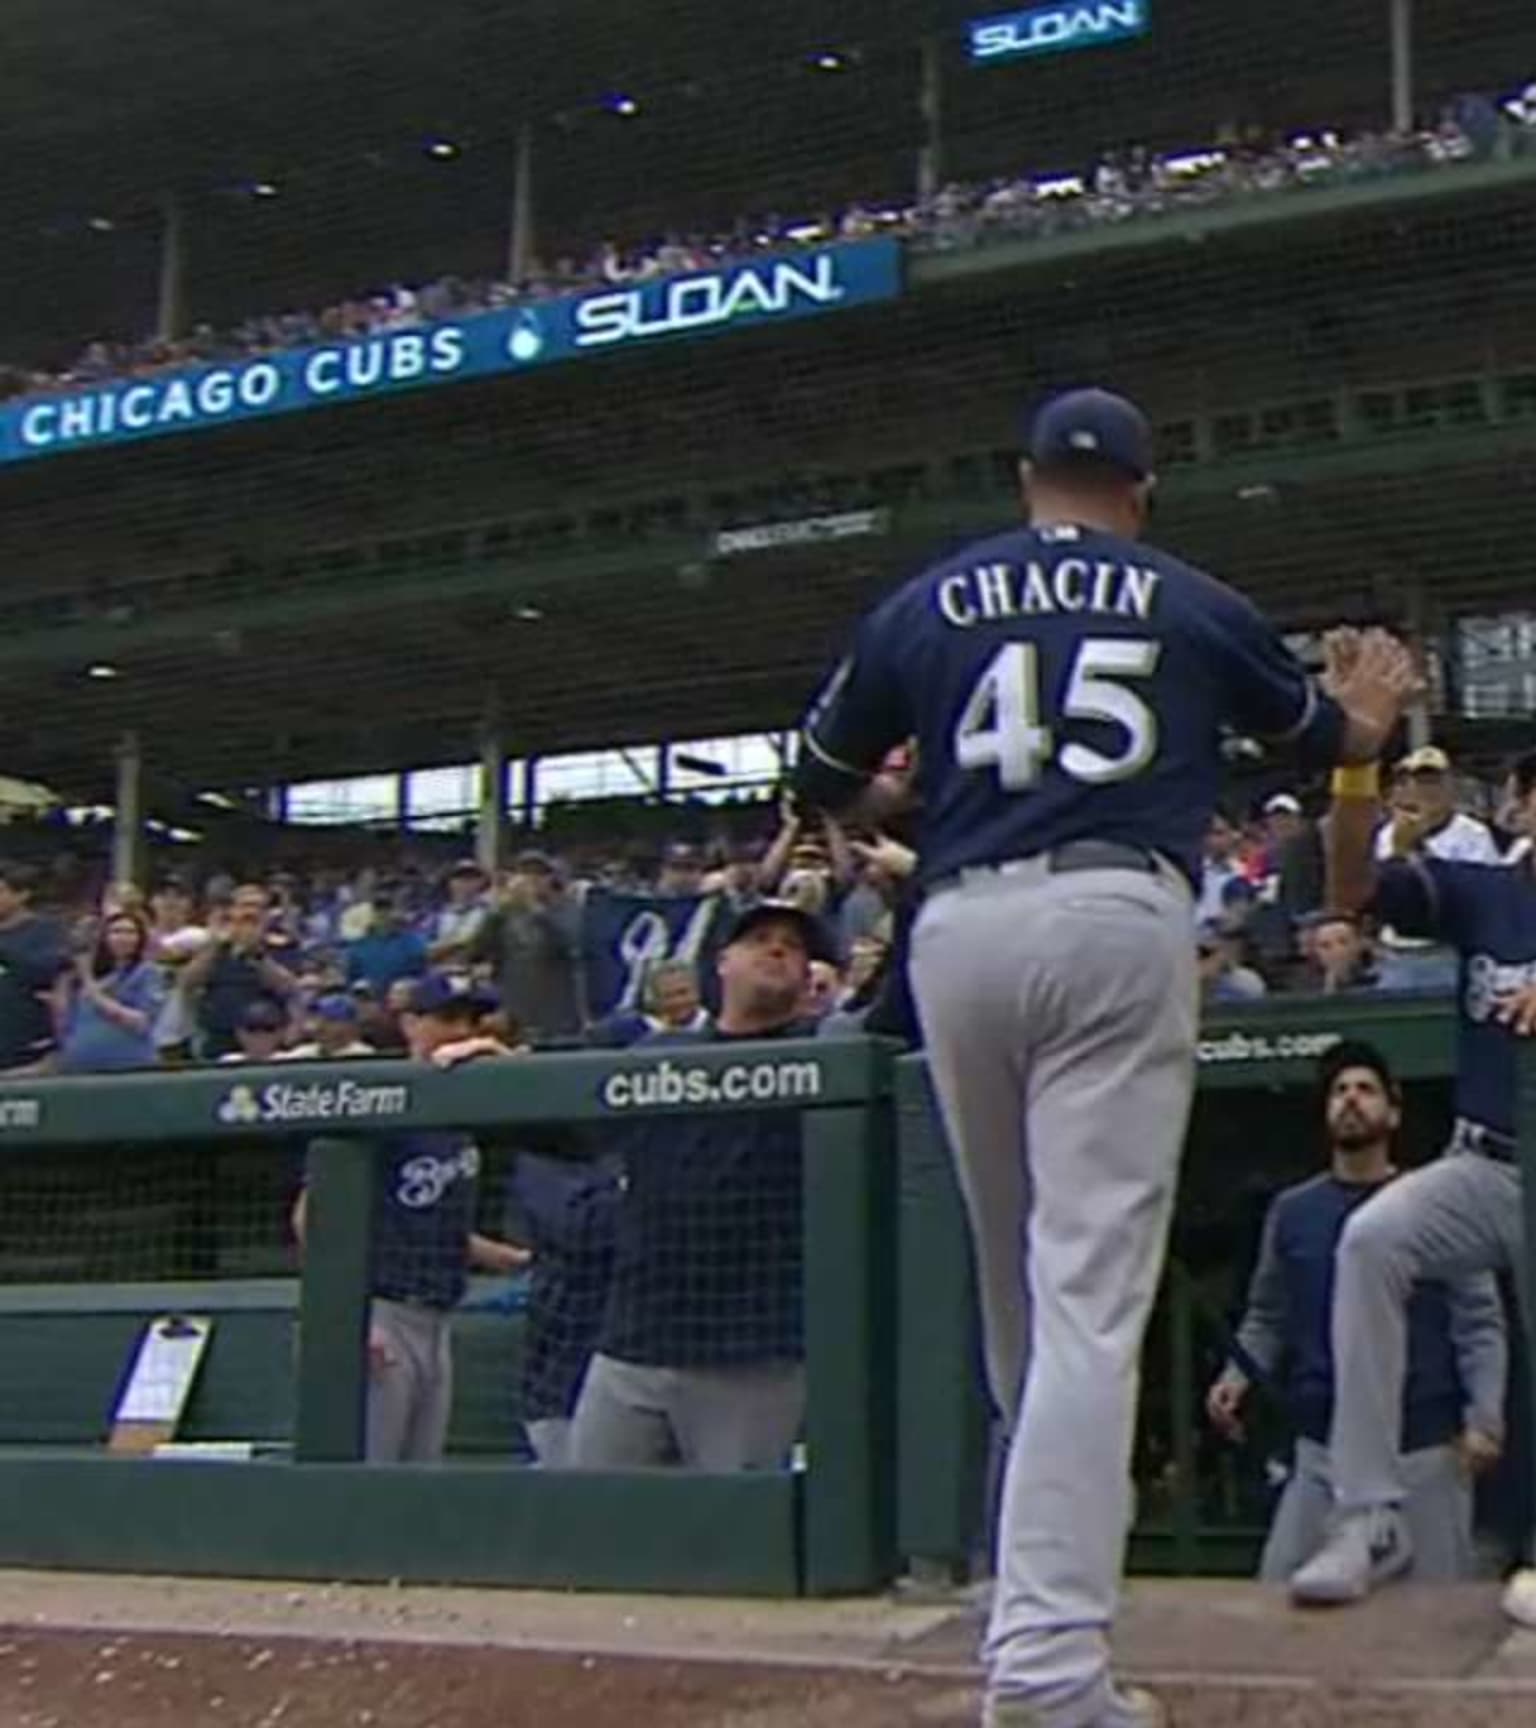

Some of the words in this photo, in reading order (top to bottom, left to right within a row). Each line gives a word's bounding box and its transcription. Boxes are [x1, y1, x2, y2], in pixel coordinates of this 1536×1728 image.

[973, 1, 1137, 56] SLOAN
[575, 256, 837, 346] SLOAN
[22, 363, 279, 445] CHICAGO
[305, 327, 465, 393] CUBS
[939, 558, 1161, 626] CHACIN
[955, 637, 1161, 791] 45
[604, 1061, 820, 1107] cubs.com
